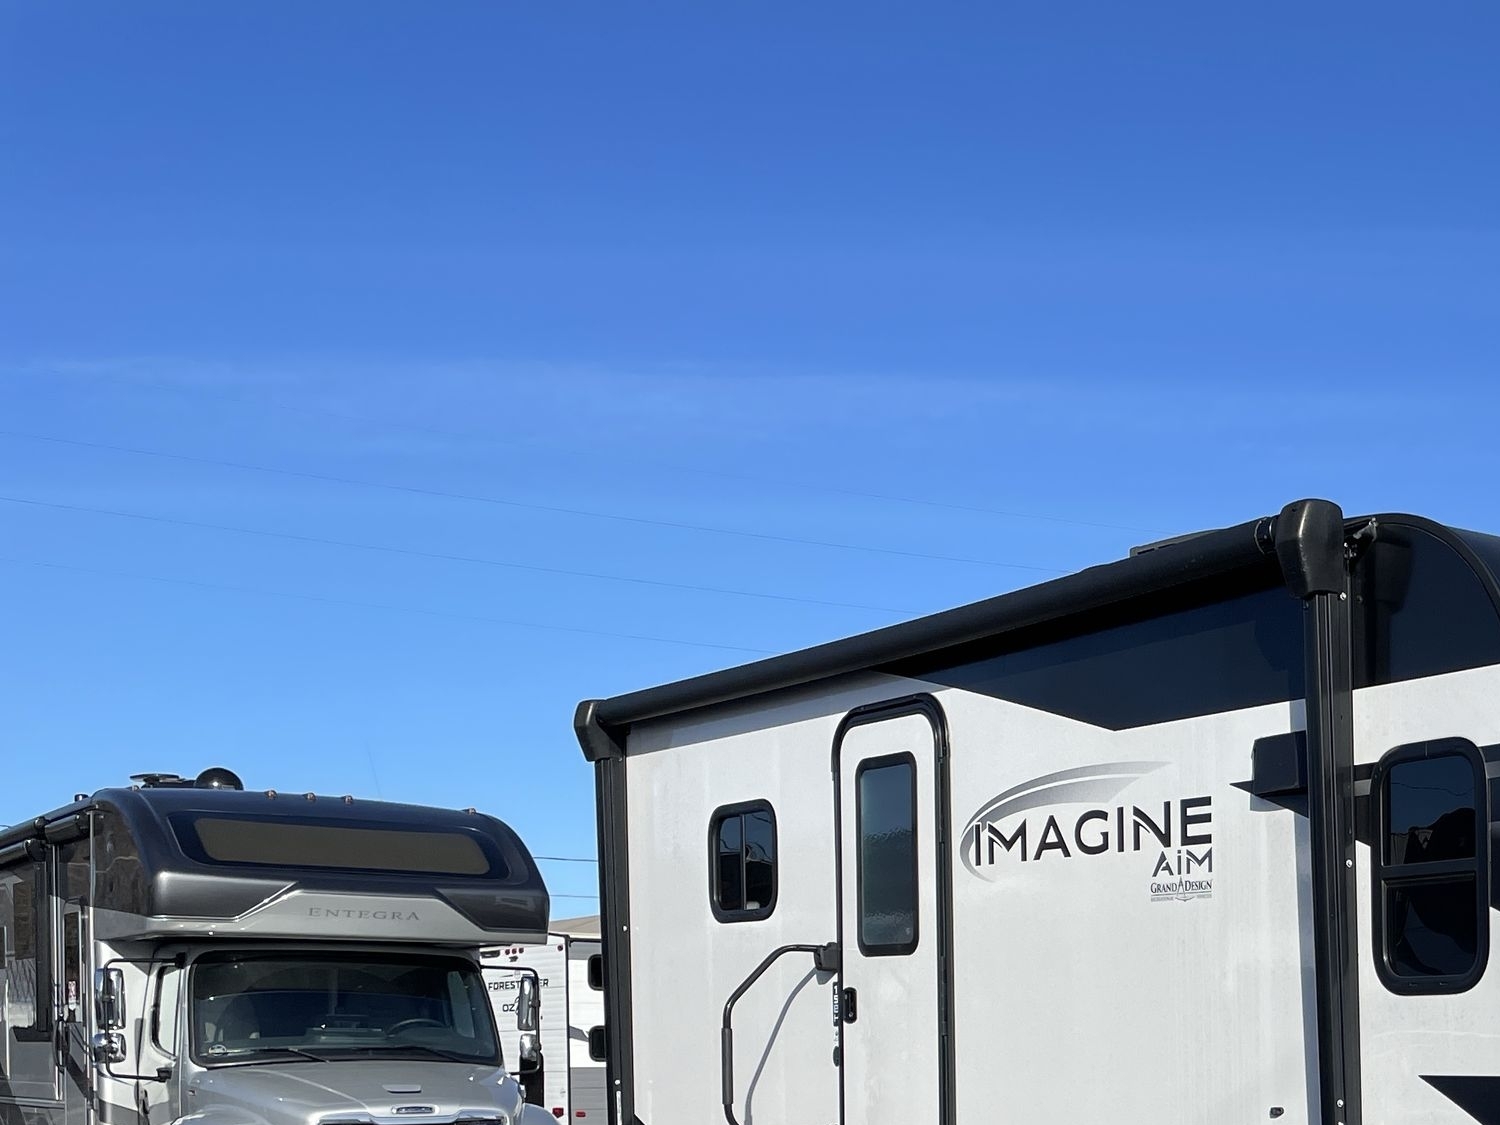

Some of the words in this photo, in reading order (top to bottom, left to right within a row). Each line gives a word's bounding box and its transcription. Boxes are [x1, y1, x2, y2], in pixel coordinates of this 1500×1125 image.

[975, 796, 1212, 866] IMAGINE
[1151, 883, 1177, 893] GRAND
[1185, 880, 1212, 891] DESIGN
[309, 907, 420, 920] ENTEGRA
